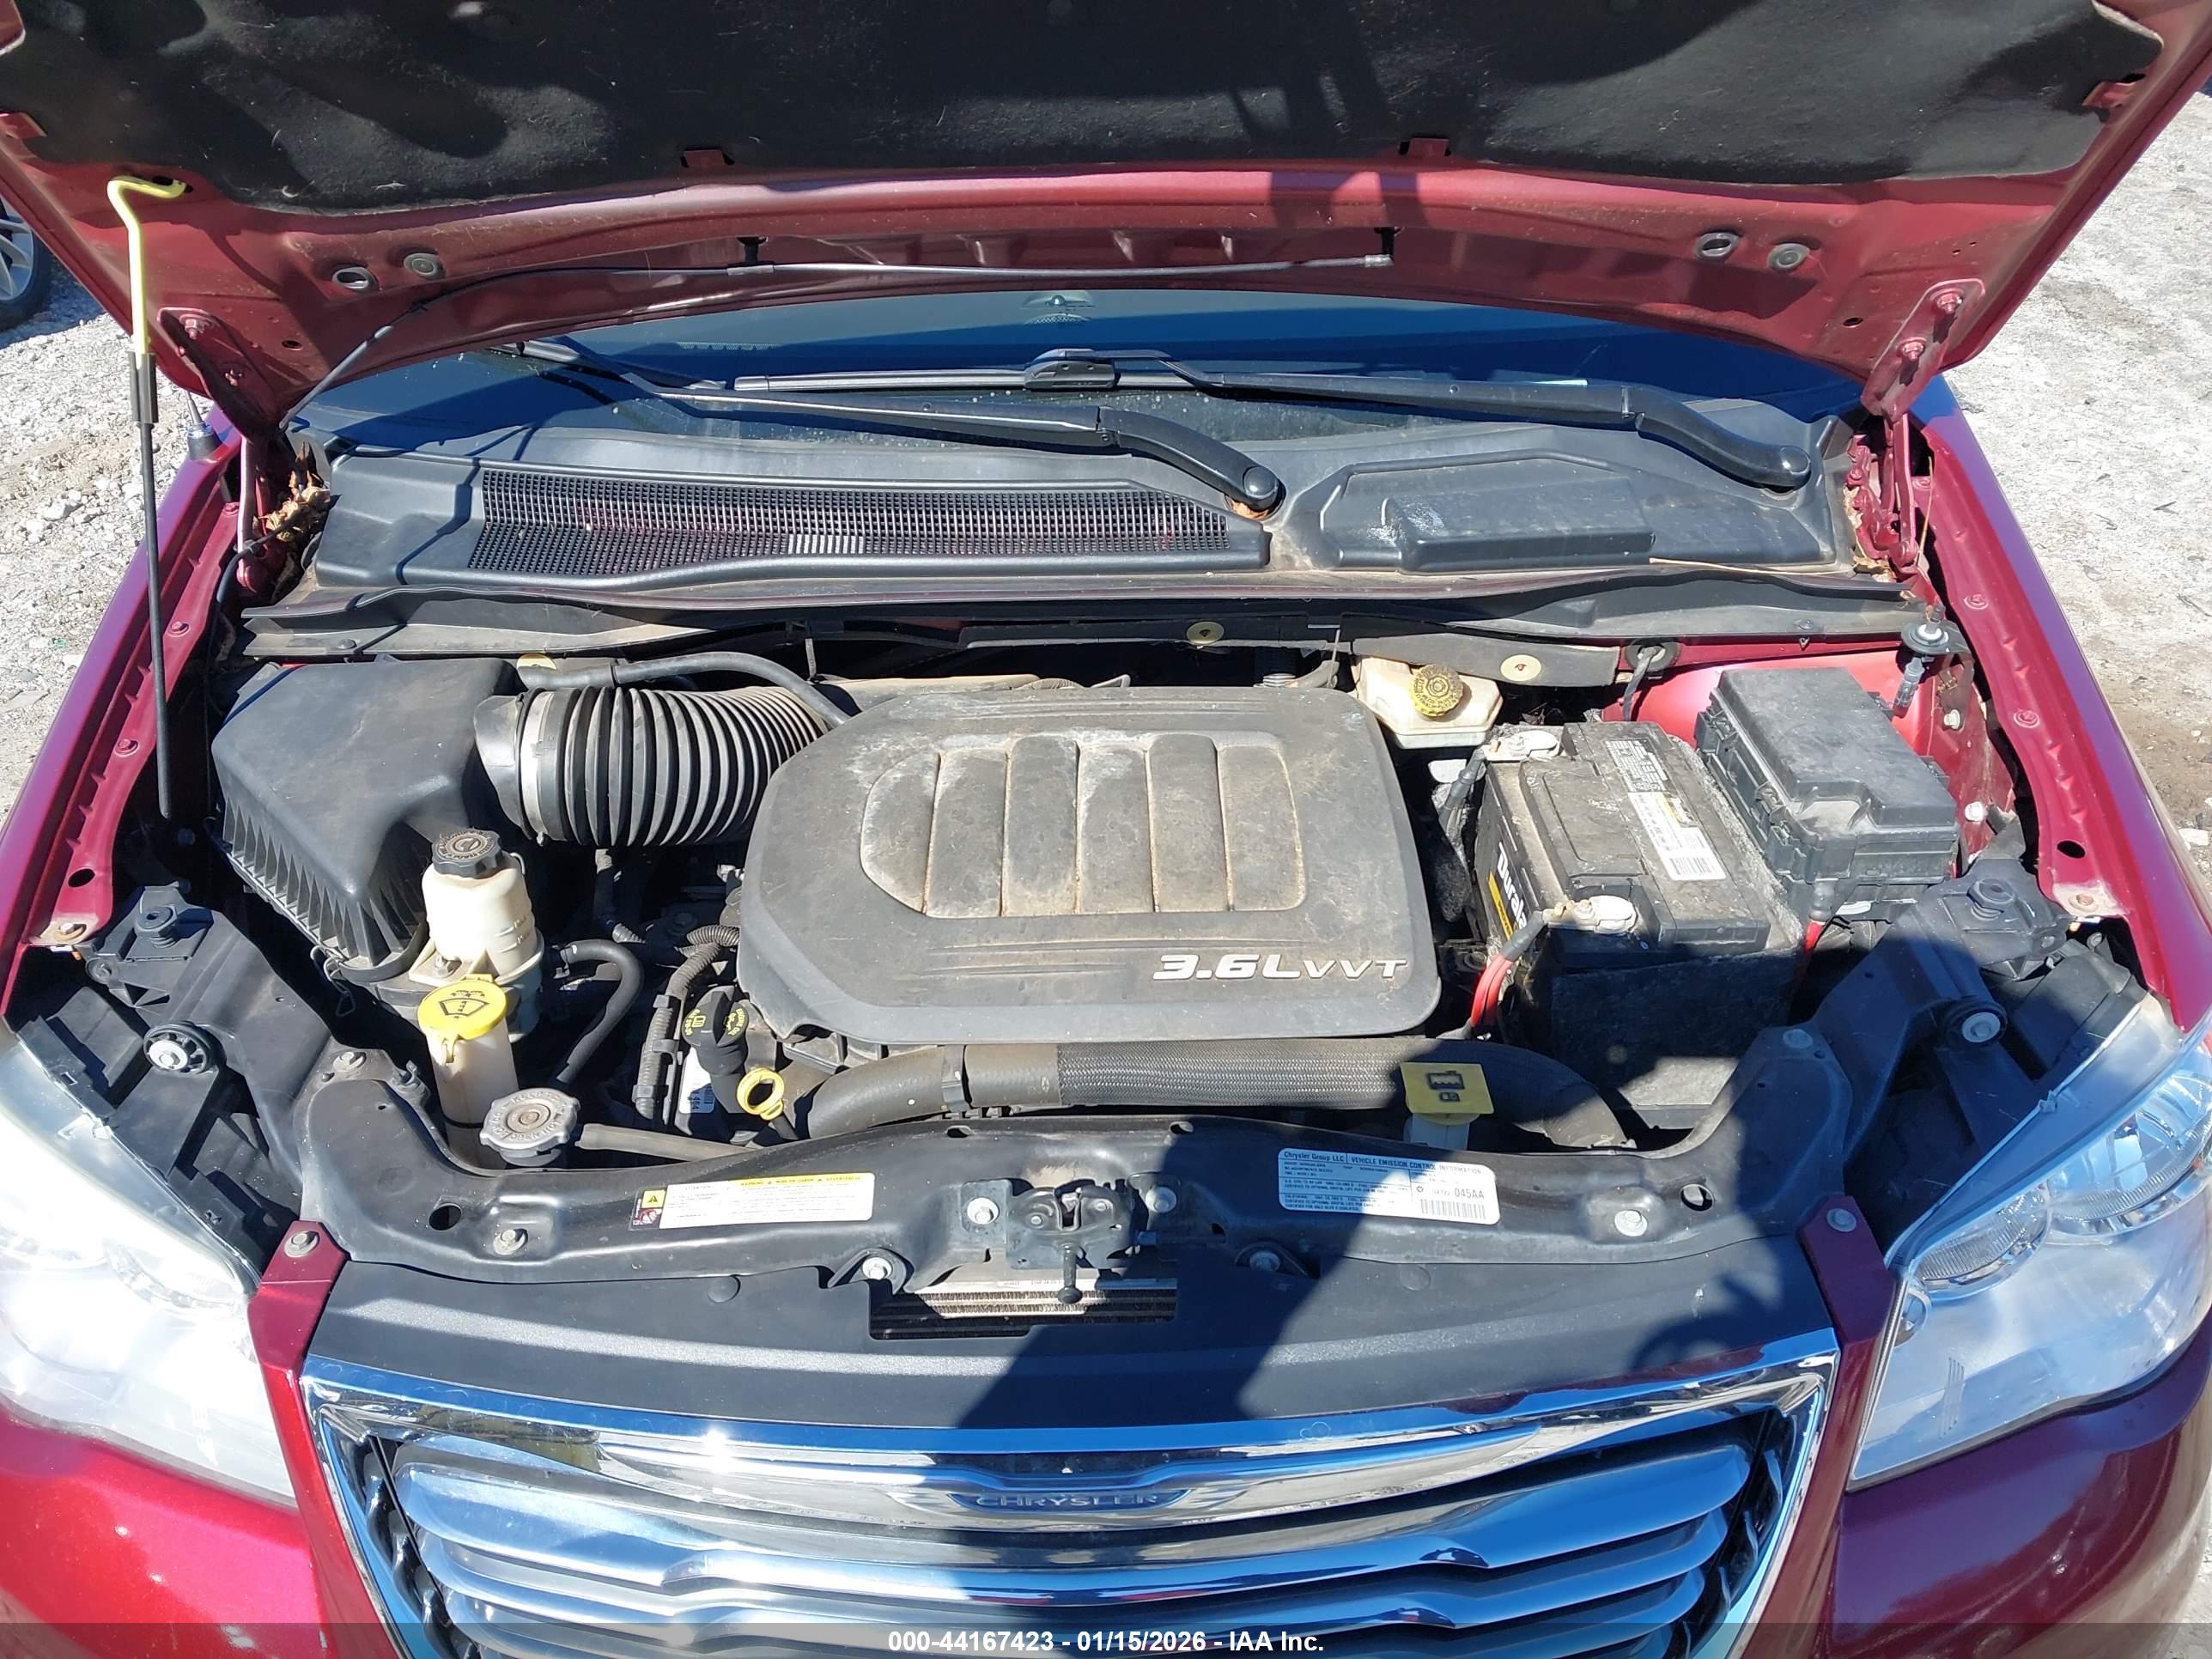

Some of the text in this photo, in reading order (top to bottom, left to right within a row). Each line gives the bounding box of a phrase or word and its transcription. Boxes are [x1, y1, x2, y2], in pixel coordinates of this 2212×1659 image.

[1498, 842, 1528, 930] Durala
[1152, 954, 1408, 981] 3.6L VVT
[1284, 1152, 1310, 1160] Chrysler
[1378, 1159, 1407, 1168] EMISSION
